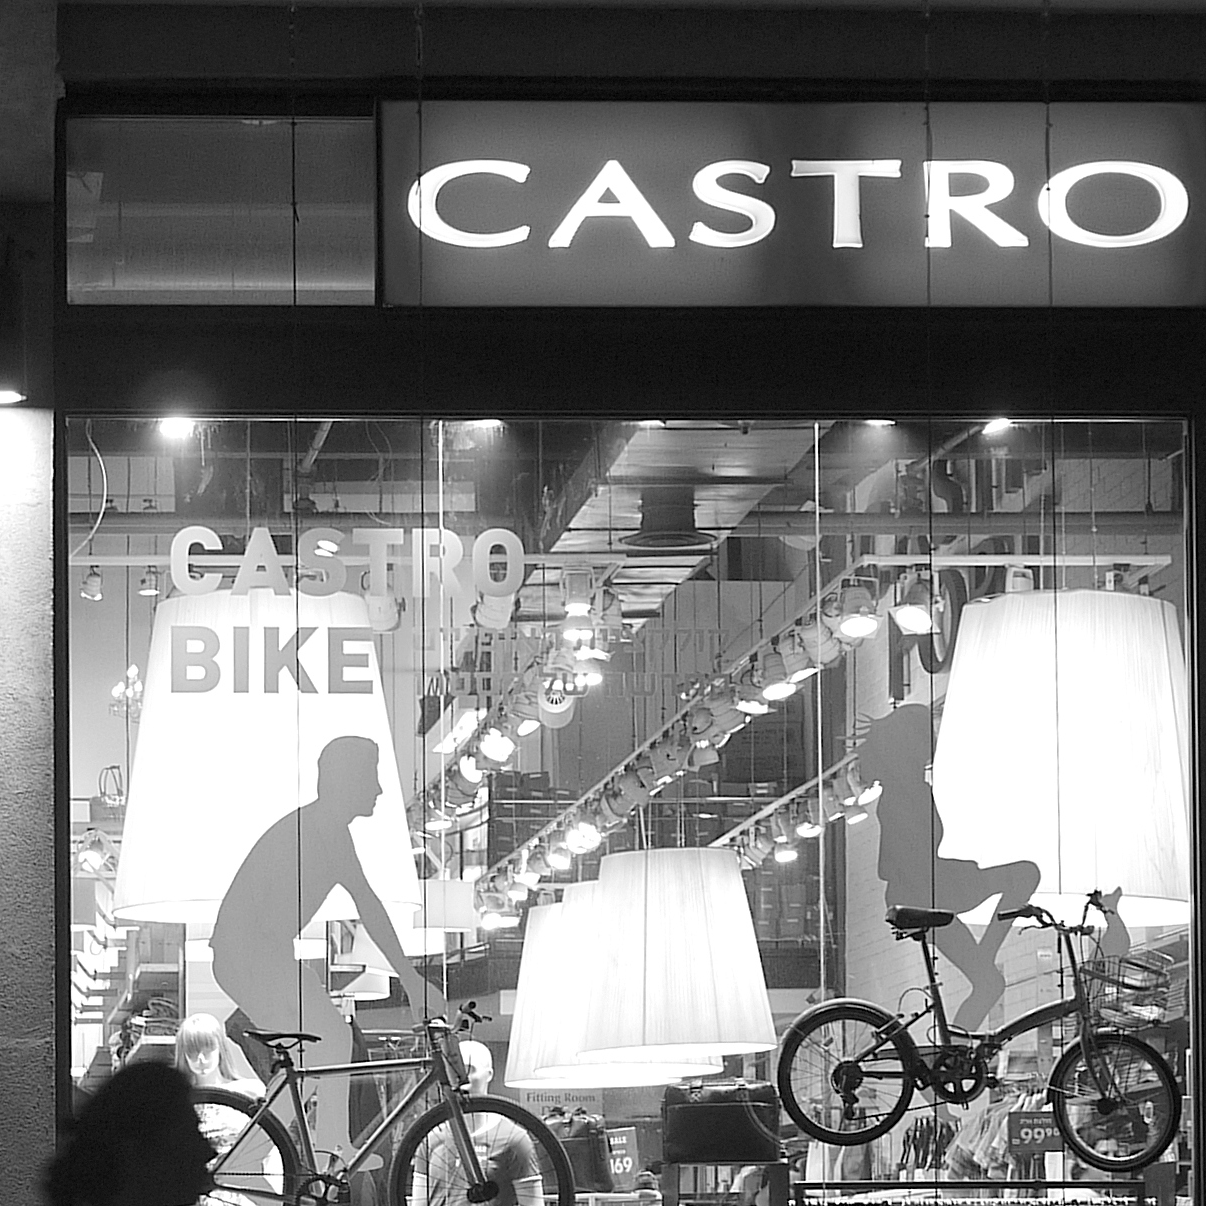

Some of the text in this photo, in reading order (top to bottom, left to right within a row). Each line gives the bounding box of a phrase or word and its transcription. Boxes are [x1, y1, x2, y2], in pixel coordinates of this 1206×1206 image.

[406, 158, 1190, 249] CASTRO
[170, 525, 525, 598] CASTRO
[170, 625, 374, 694] BIKE
[526, 1092, 596, 1104] Fitting Room
[609, 1156, 633, 1174] 169
